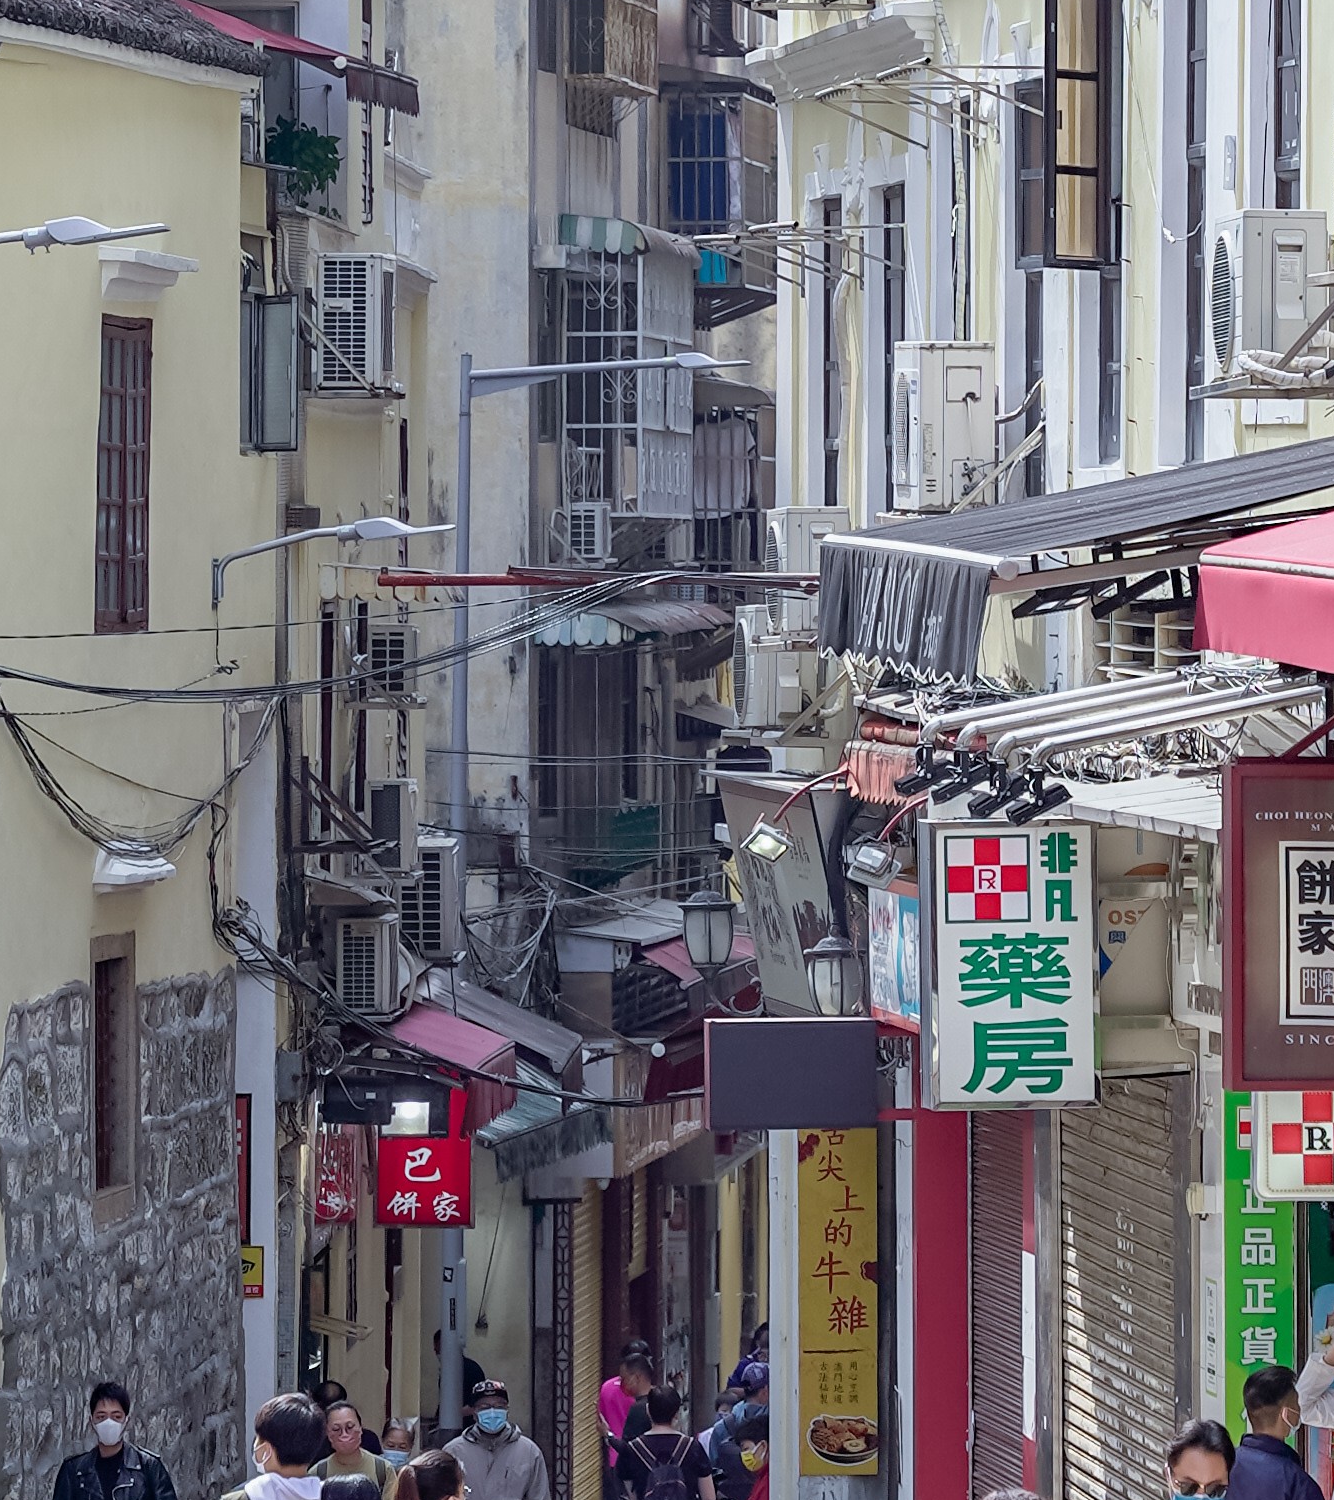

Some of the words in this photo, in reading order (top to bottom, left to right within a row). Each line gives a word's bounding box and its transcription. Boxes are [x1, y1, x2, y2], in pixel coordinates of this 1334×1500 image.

[1255, 811, 1289, 821] CHOI
[1040, 832, 1078, 921] 非凡
[957, 932, 1072, 1094] 藥房
[405, 1147, 441, 1182] 巴
[812, 1128, 869, 1335] 舌尖上的牛雜
